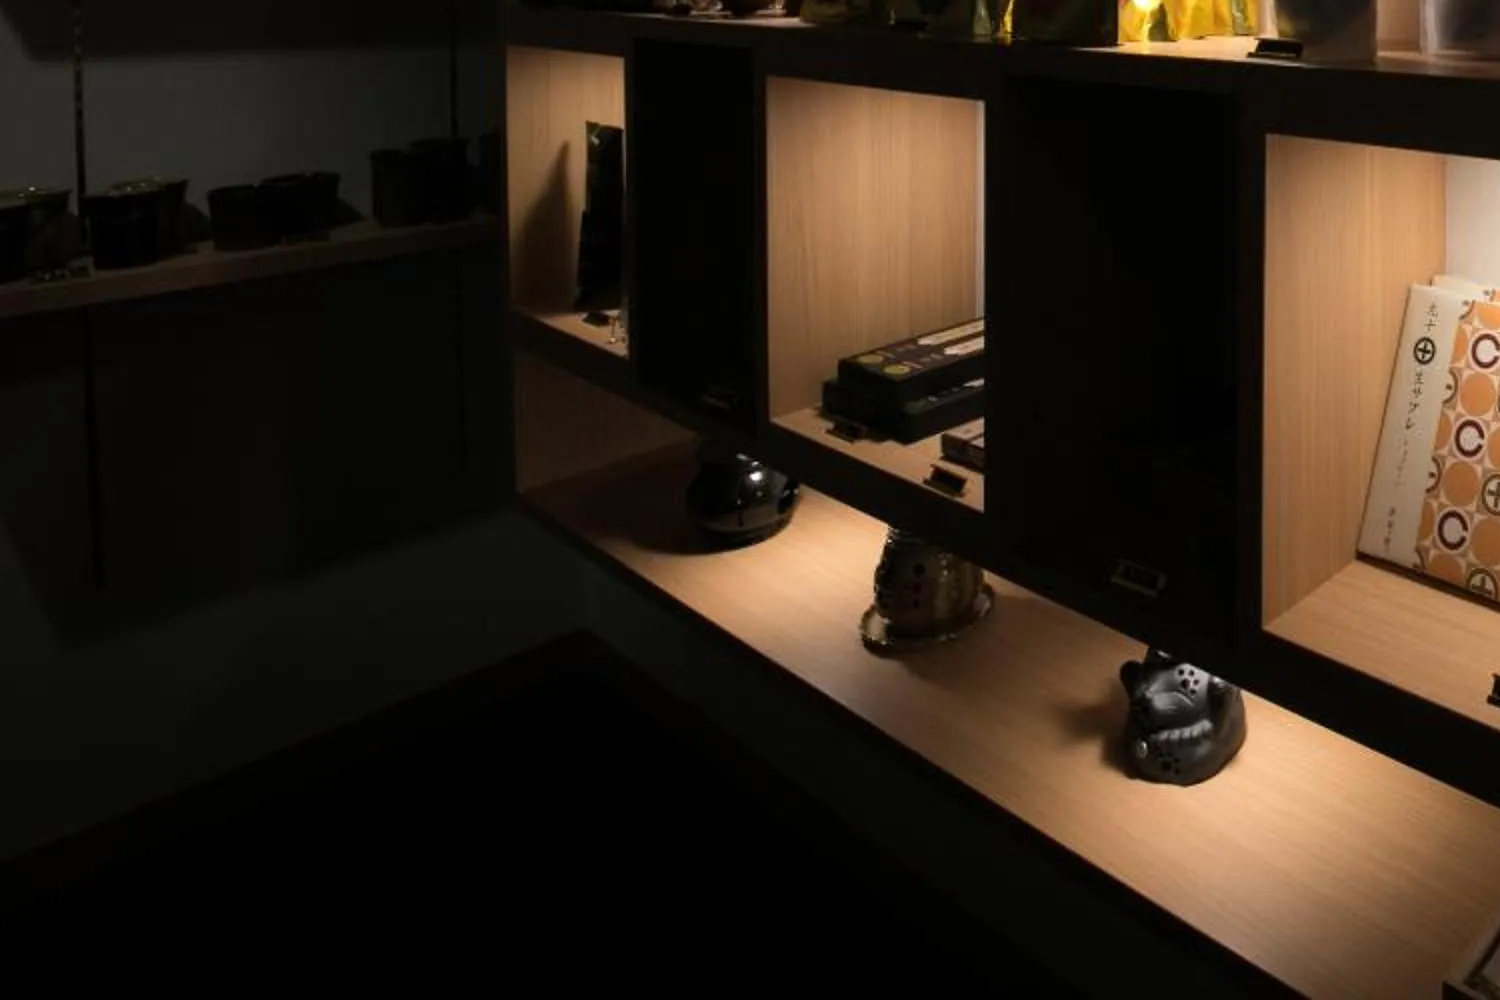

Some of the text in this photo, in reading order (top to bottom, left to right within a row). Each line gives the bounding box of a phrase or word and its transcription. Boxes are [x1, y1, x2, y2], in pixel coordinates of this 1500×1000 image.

[1471, 333, 1500, 369] C
[1455, 419, 1485, 458] C
[1438, 510, 1468, 551] C
